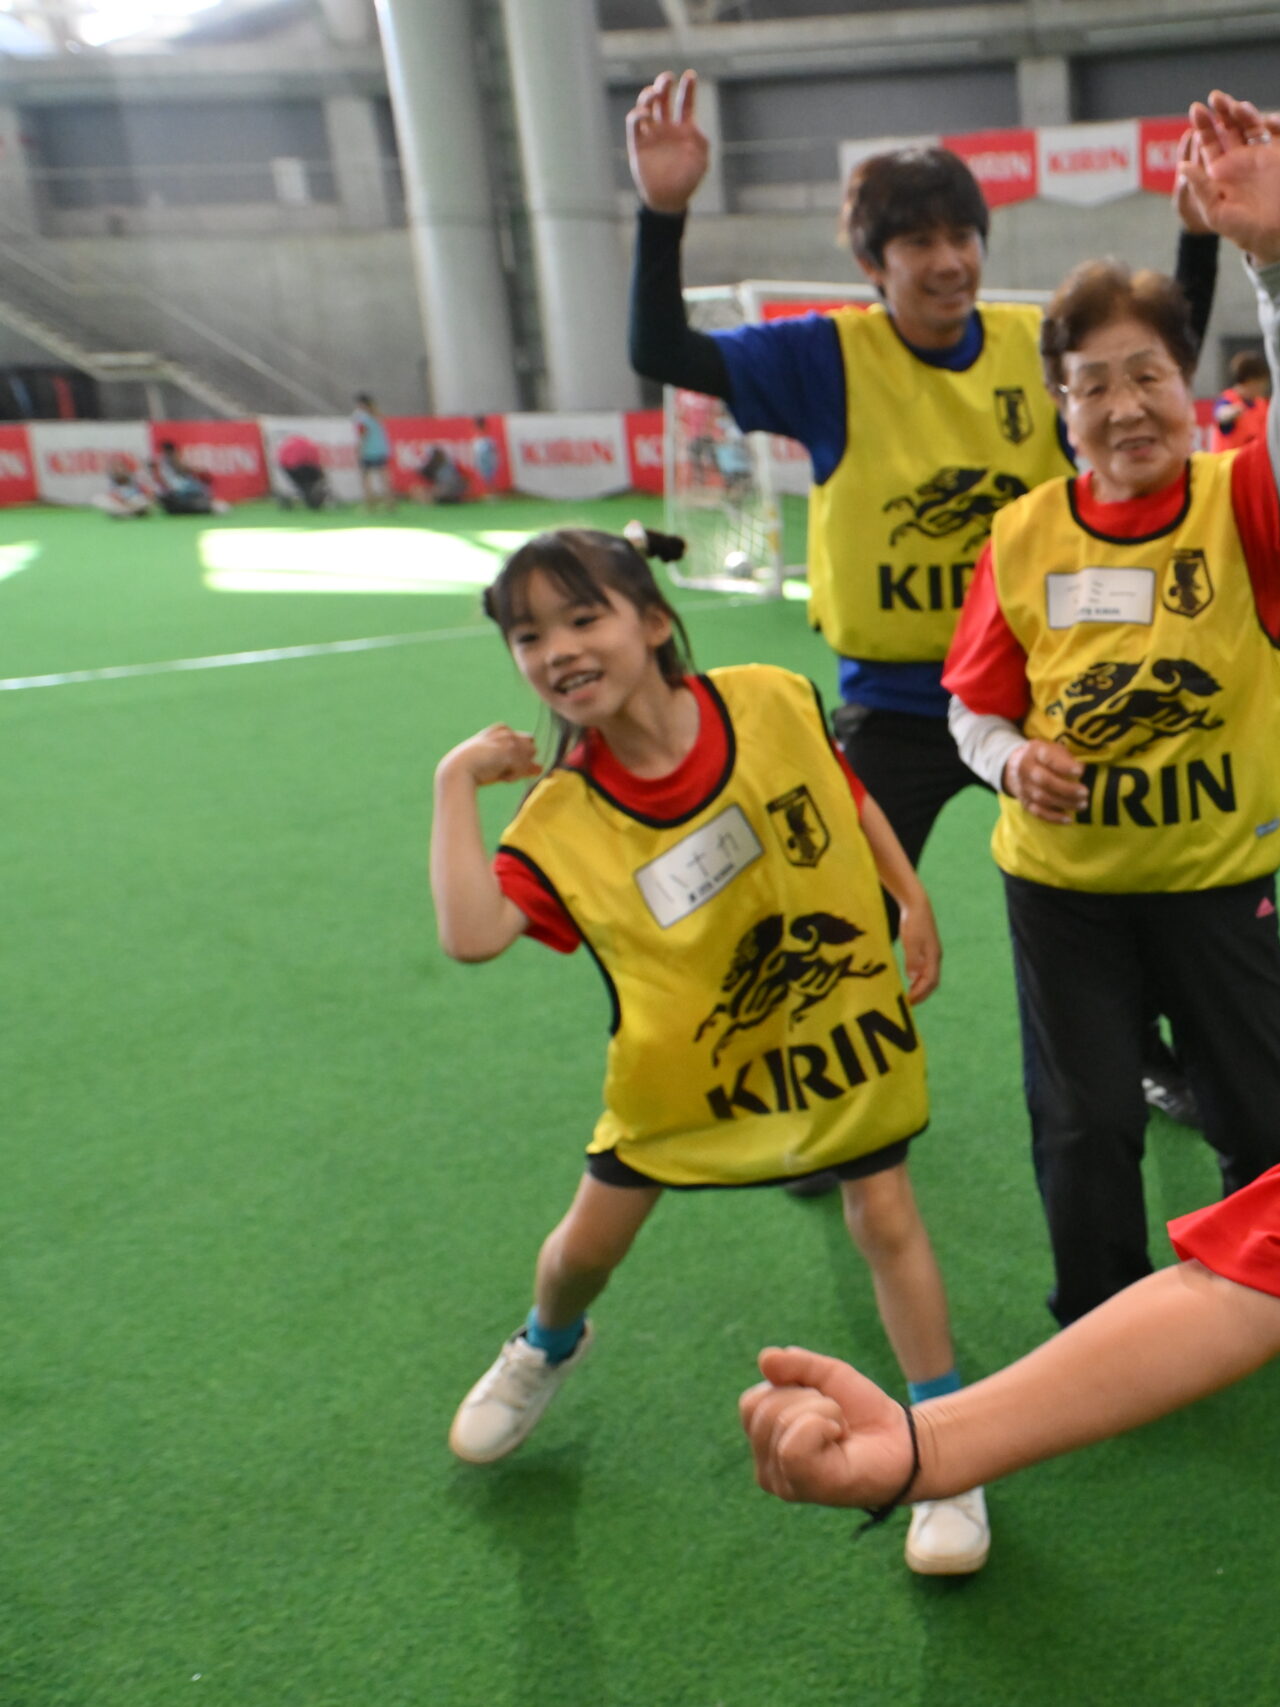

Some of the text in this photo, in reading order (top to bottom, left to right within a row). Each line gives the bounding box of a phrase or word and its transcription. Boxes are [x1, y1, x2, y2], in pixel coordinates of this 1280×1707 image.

[1049, 147, 1130, 175] KIRIN
[1075, 752, 1237, 827] IRIN
[706, 993, 918, 1120] KIRIN
